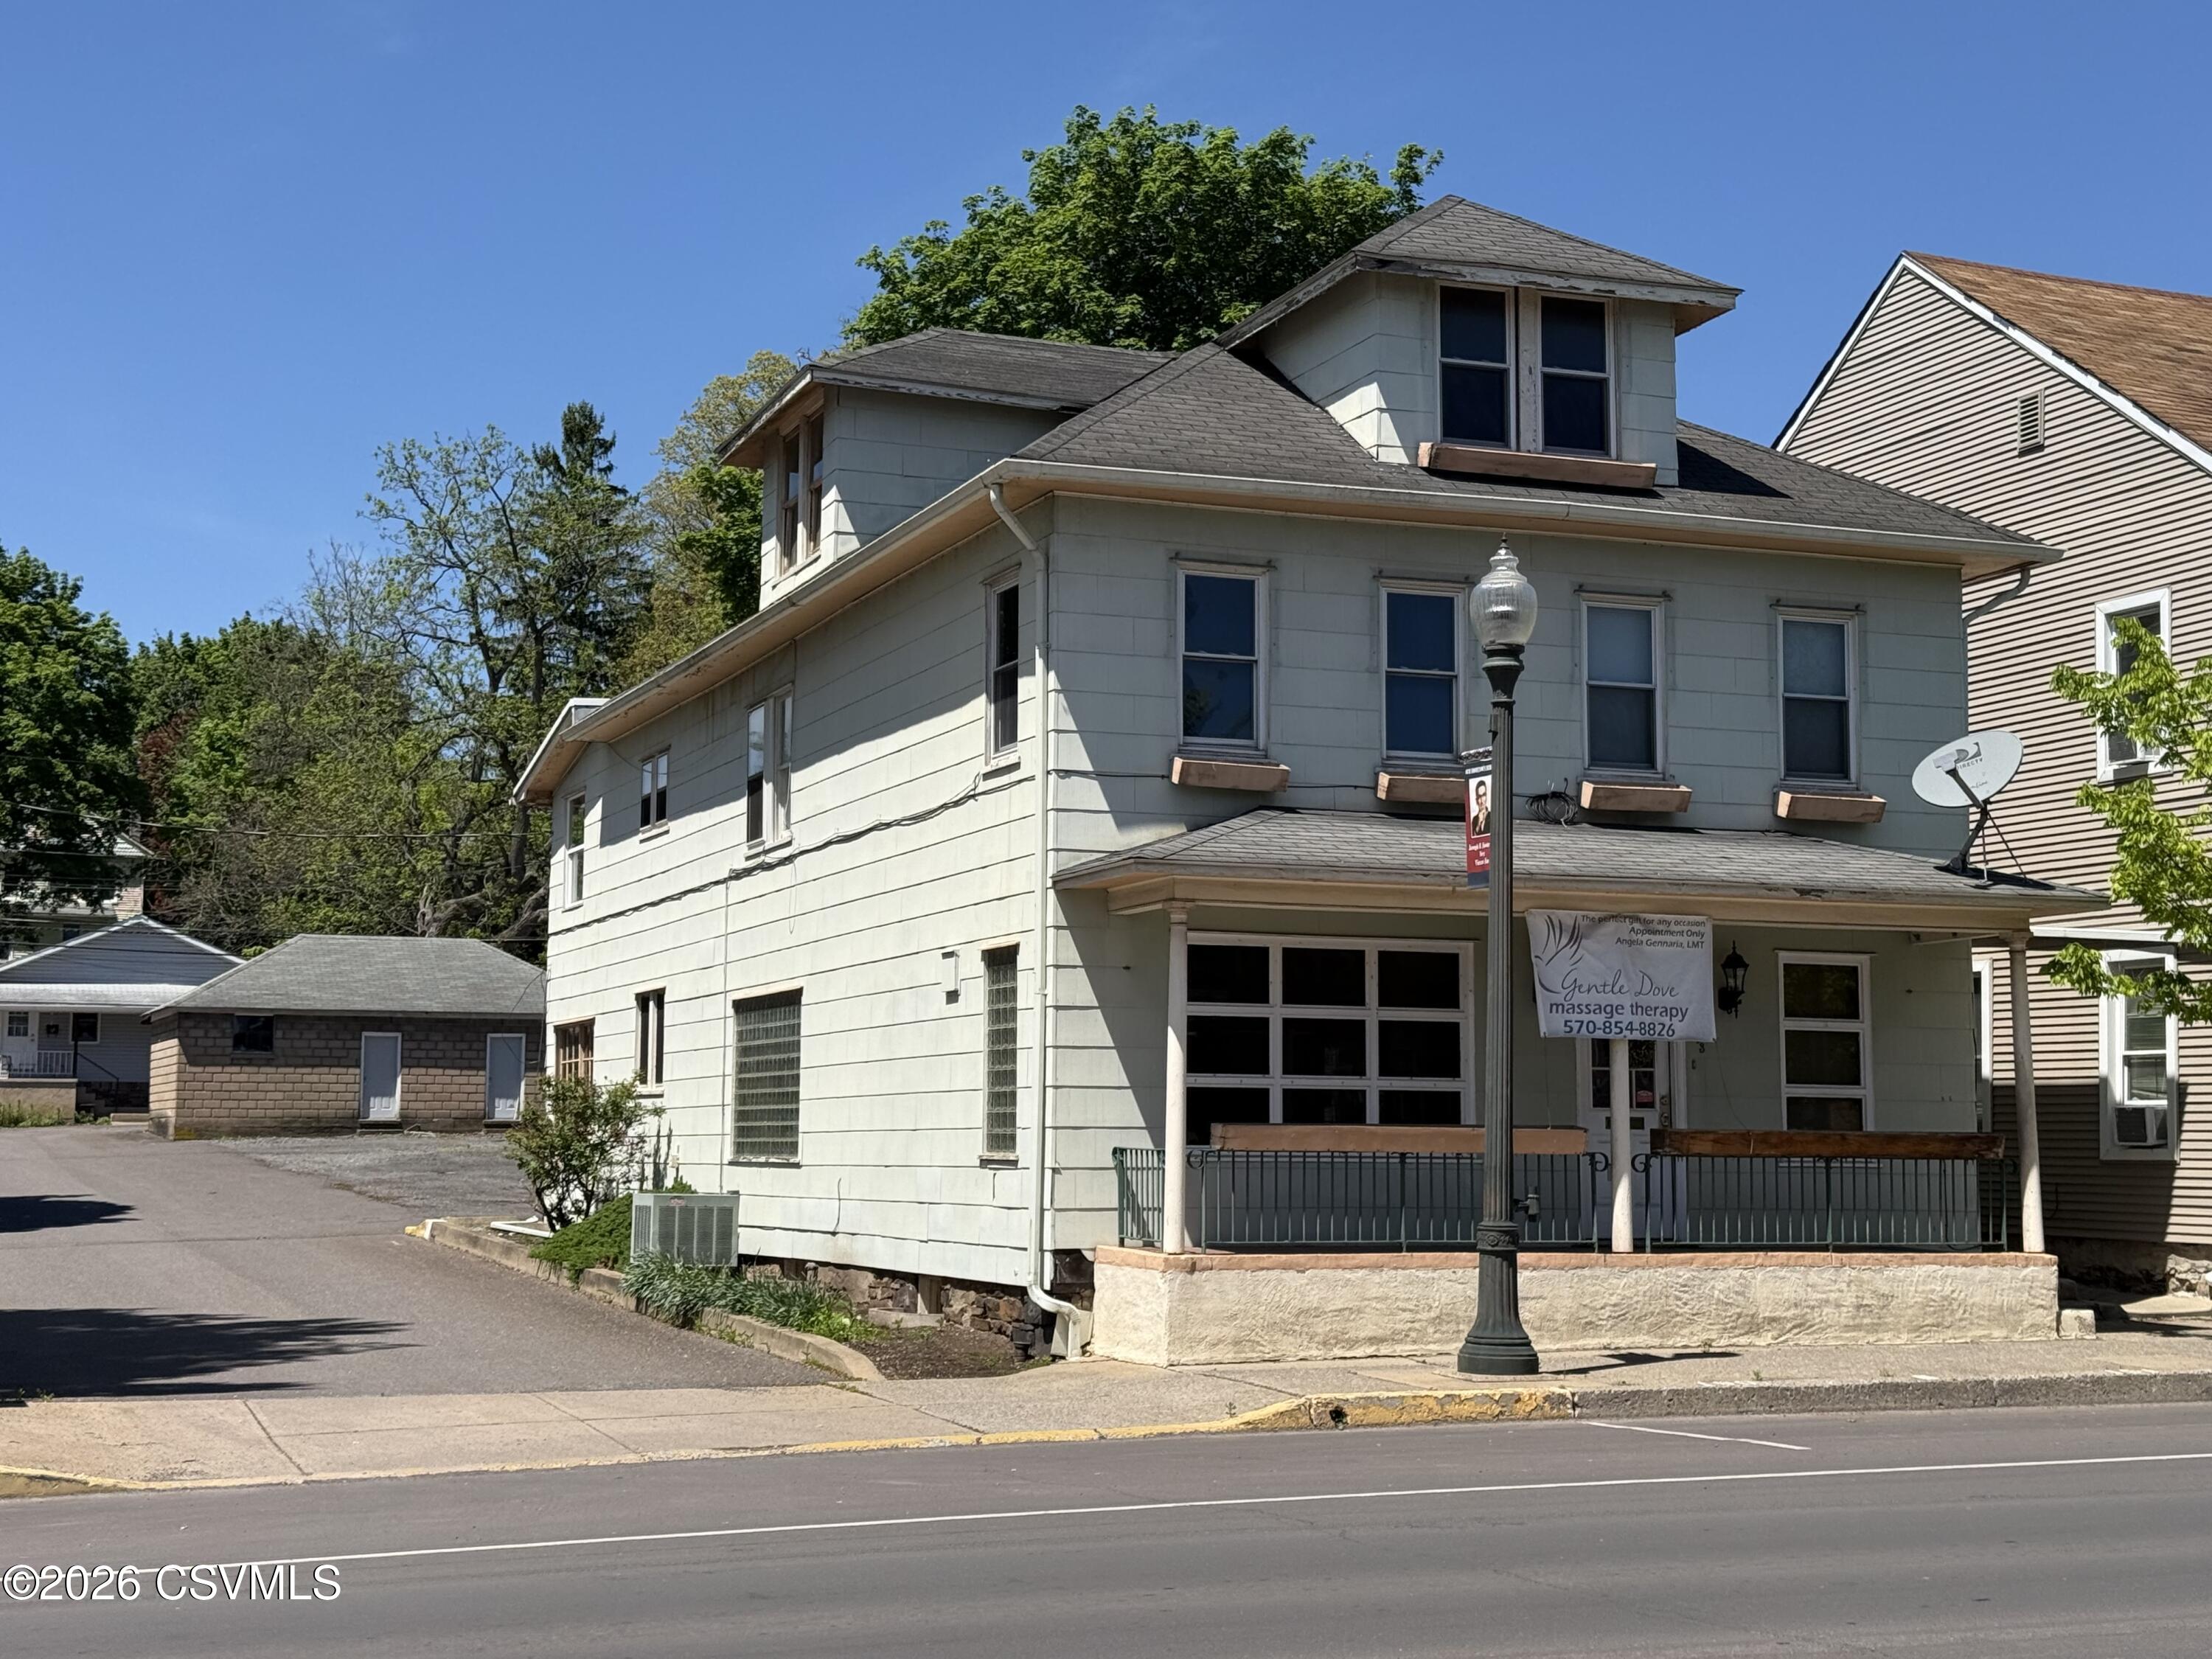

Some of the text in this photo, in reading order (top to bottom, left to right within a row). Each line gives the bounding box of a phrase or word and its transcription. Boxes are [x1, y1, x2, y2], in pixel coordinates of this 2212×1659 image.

[1644, 917, 1655, 925] for
[1657, 919, 1672, 928] any
[1629, 927, 1705, 939] Appointment Only
[1615, 937, 1644, 947] Angela
[1687, 940, 1705, 949] LMT
[1561, 967, 1680, 1002] Gentle Dove
[1549, 1001, 1688, 1023] massage therapy
[1563, 1020, 1676, 1037] 570-854-8826
